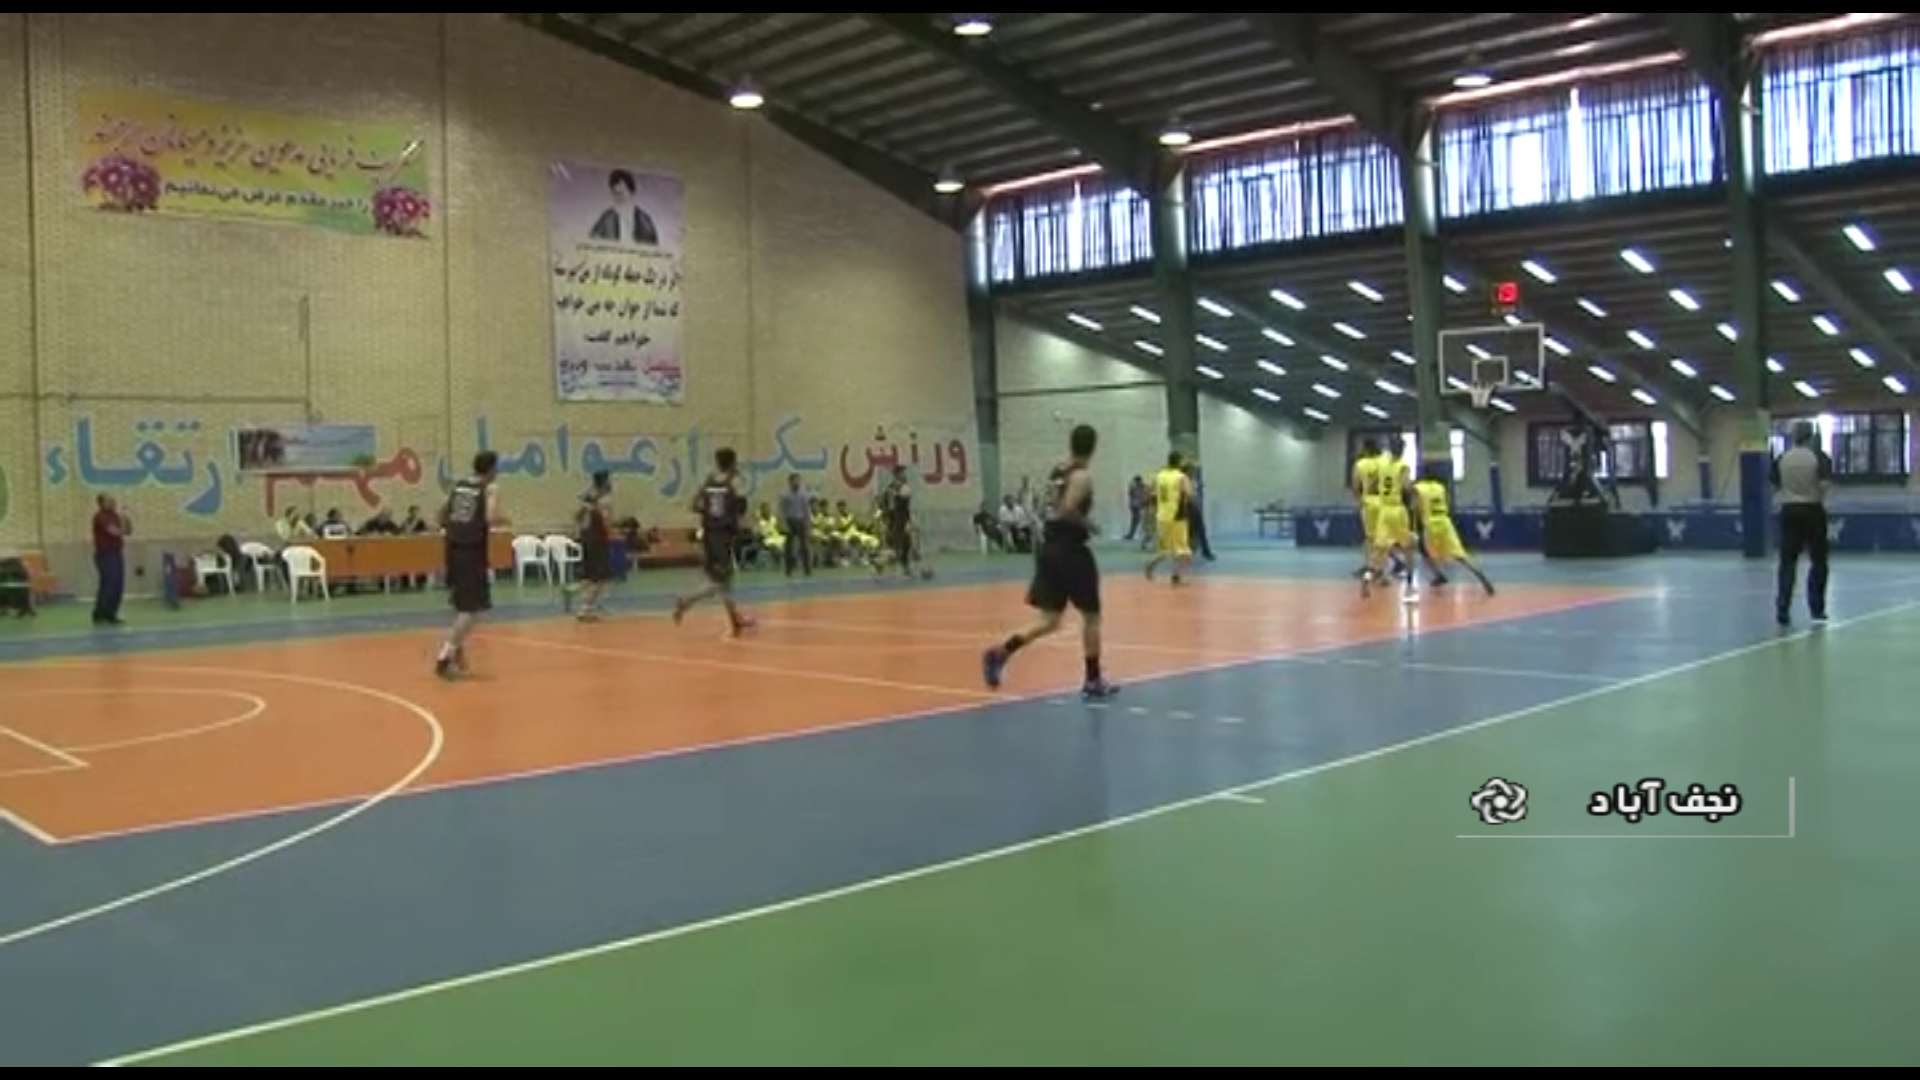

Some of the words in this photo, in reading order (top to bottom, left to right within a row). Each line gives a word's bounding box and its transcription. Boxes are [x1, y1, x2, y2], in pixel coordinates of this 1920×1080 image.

[437, 415, 657, 498] عوامل
[659, 424, 698, 498] از
[840, 425, 968, 488] ورزش
